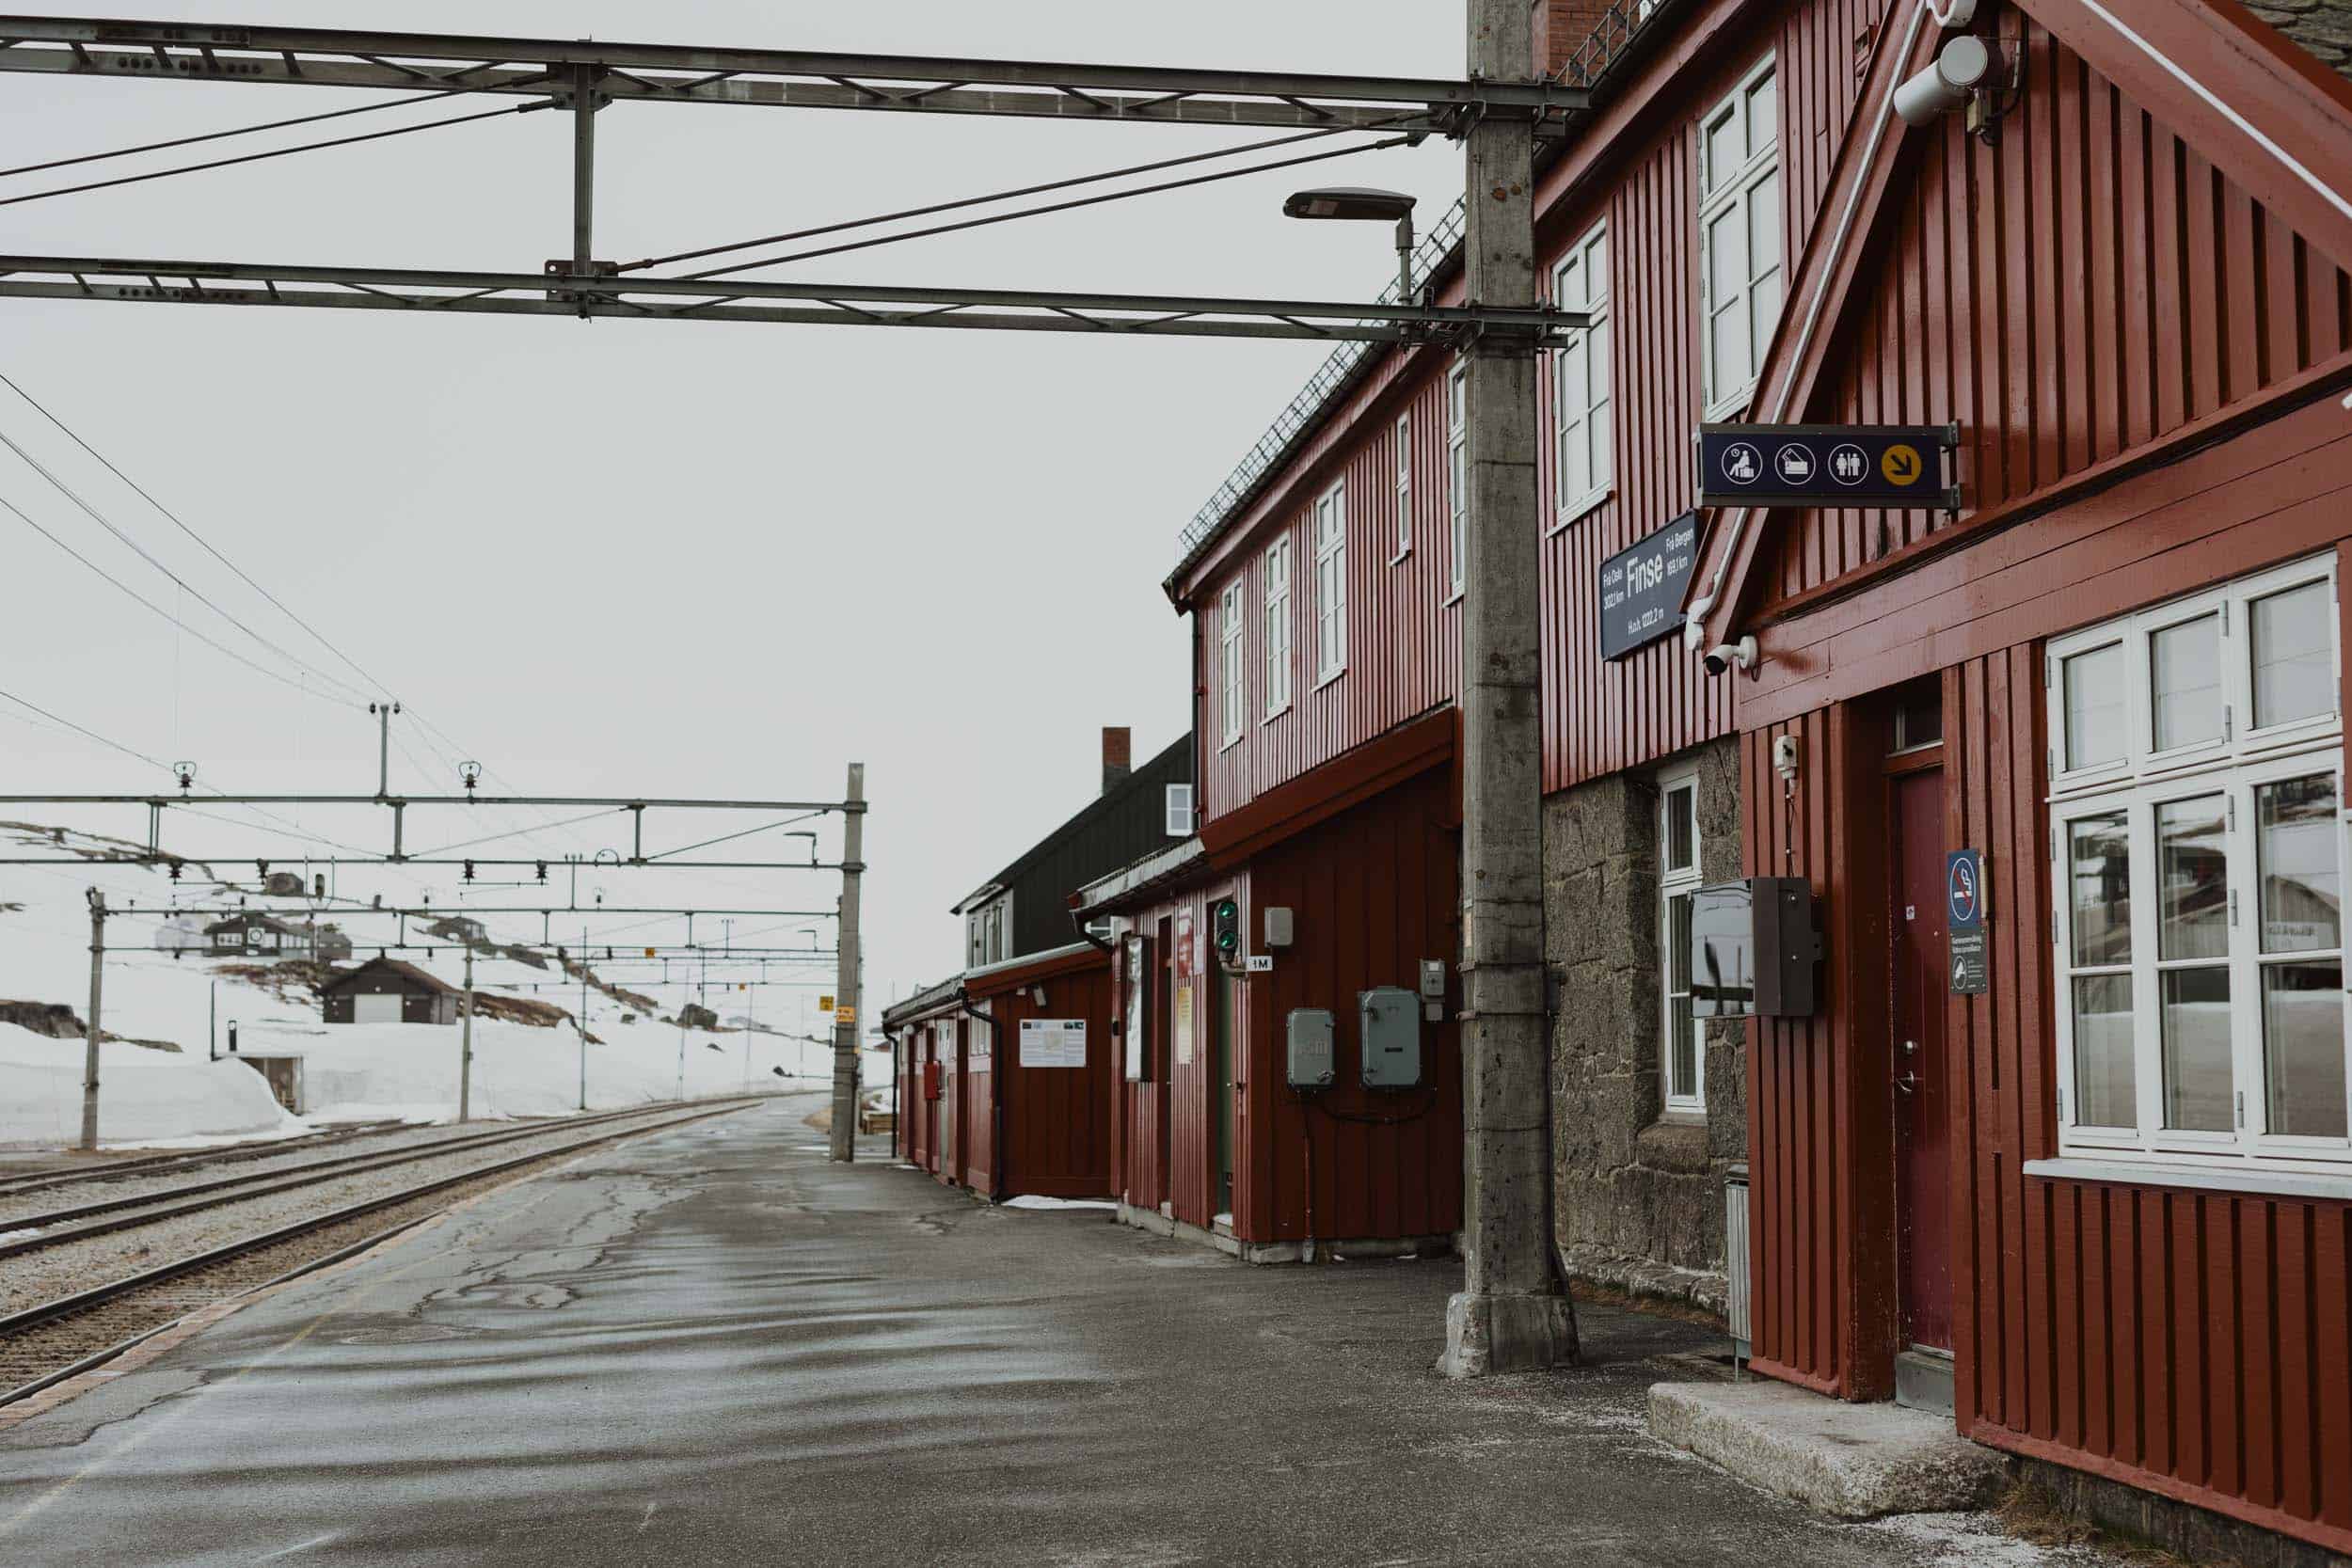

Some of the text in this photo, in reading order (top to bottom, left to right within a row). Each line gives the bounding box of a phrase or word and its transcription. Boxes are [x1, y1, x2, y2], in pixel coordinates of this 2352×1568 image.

[1675, 528, 1693, 547] Bergen
[1679, 556, 1688, 570] km
[1612, 567, 1623, 583] Oslo
[1627, 553, 1663, 598] Finse
[1616, 591, 1625, 603] km
[1658, 608, 1664, 620] m
